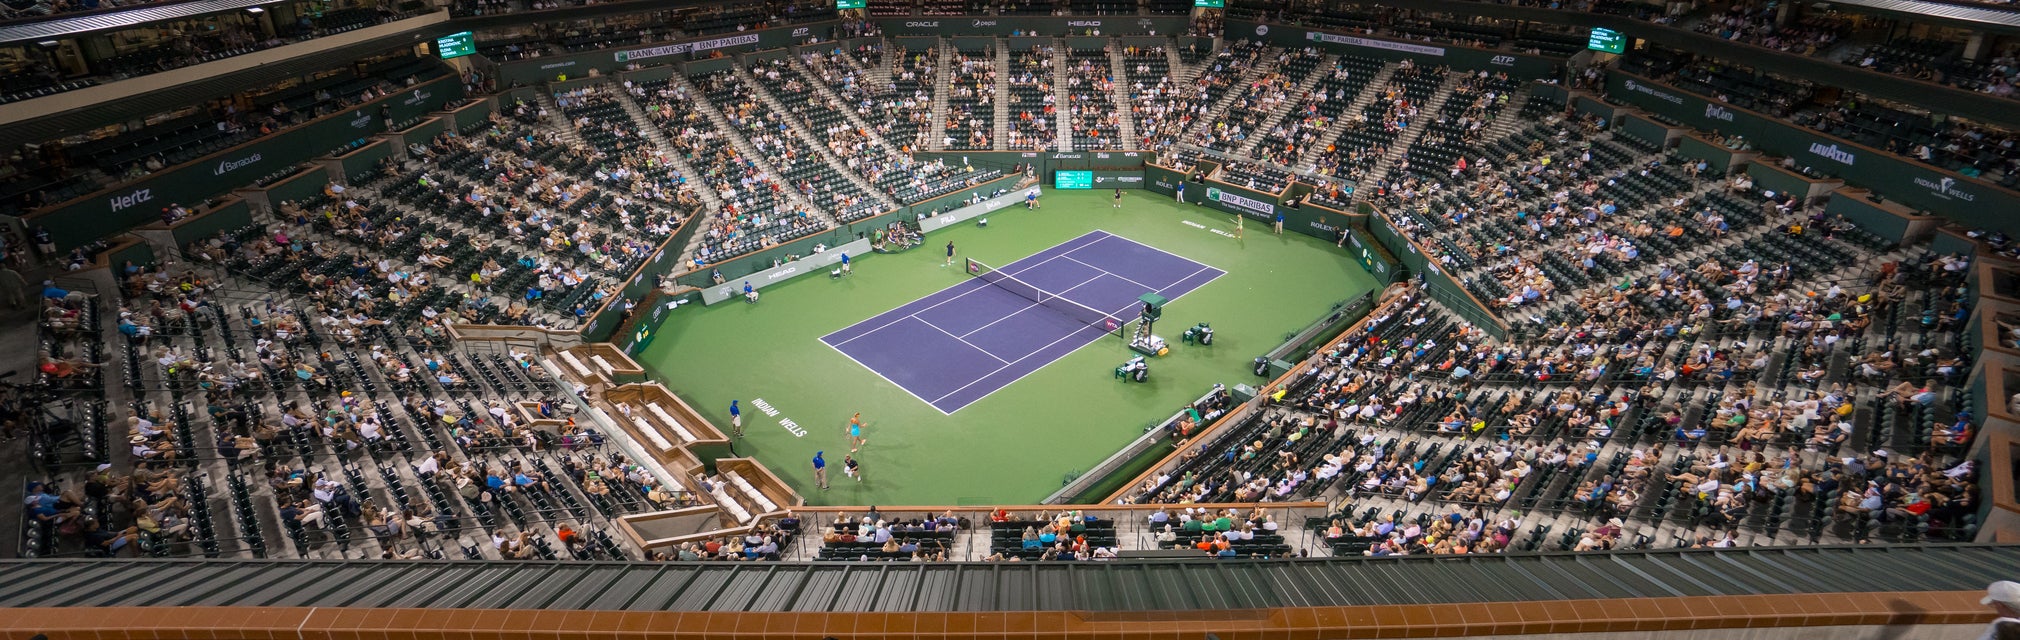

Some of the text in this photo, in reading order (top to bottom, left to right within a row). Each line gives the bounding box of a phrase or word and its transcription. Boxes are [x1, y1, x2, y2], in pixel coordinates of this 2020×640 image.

[700, 34, 757, 50] BNP PARIBAS
[1338, 35, 1362, 44] PARIBAS
[628, 49, 654, 58] BANK
[662, 44, 687, 54] WEST
[224, 152, 262, 173] Barracuda
[1809, 142, 1854, 166] LAVAZZA
[1914, 176, 1940, 192] INDIAN
[1949, 186, 1974, 202] WELLS
[110, 188, 151, 212] Hertz
[1222, 193, 1270, 212] BNP PARIBAS
[940, 215, 956, 224] FILA
[1310, 220, 1333, 232] ROLEX
[768, 266, 796, 280] HEAD
[752, 398, 808, 438] INDIAN WELLS
